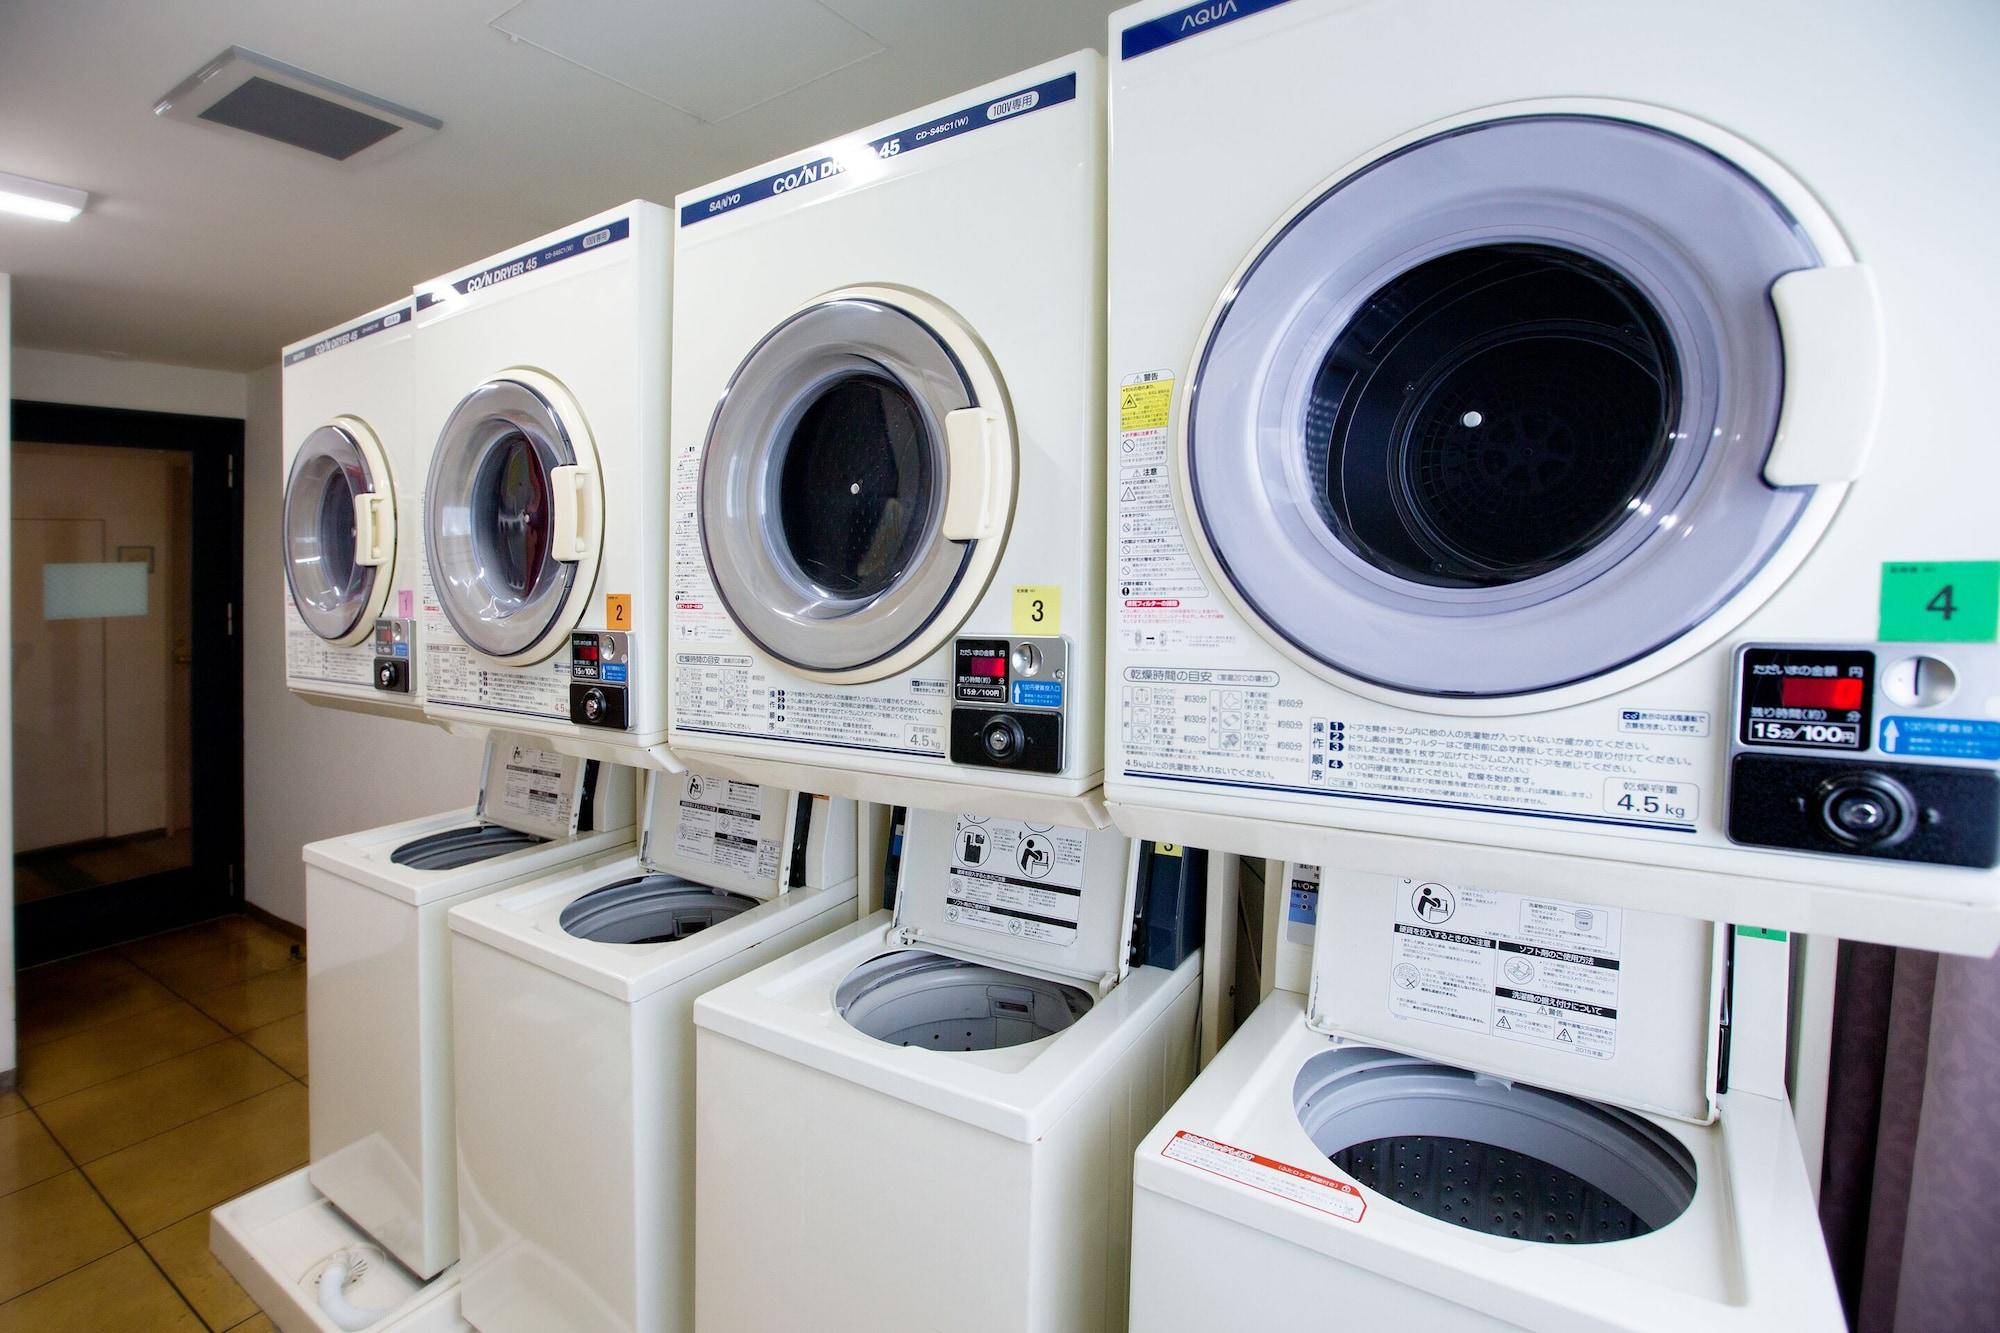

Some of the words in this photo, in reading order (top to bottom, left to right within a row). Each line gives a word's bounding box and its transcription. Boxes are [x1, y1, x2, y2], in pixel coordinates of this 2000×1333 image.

[1181, 0, 1238, 31] AQUA
[993, 94, 1033, 118] 100V専用
[709, 192, 741, 212] SANYO
[773, 165, 818, 194] COIN
[880, 138, 900, 159] 45
[915, 115, 969, 141] CD-S45C1(W)
[467, 272, 493, 293] COIN
[494, 261, 524, 283] DRYER
[525, 256, 538, 271] 45
[1143, 467, 1157, 476] 注意
[616, 604, 623, 621] 2
[1031, 600, 1044, 622] 3
[1925, 584, 1958, 621] 4
[1130, 669, 1212, 682] 乾燥時間の目安
[1753, 664, 1838, 677] ただいまの金額
[1848, 666, 1863, 678] 円
[963, 688, 1000, 697] 15分/100円
[555, 703, 565, 713] 4.5
[1751, 706, 1827, 721] 残り時間(約)
[1846, 710, 1862, 723] 分
[910, 734, 930, 747] 4.5
[1754, 722, 1856, 743] 15分/100円
[1623, 781, 1678, 795] 乾燥容量
[1617, 793, 1660, 813] 4.5
[1665, 803, 1685, 819] kg
[1399, 925, 1491, 948] 硬貨を投入するときのご注意
[1519, 945, 1595, 966] ソフト剤のご使用方法
[1511, 990, 1603, 1016] 洗濯機の据え付けについて
[1549, 1008, 1563, 1018] 警告
